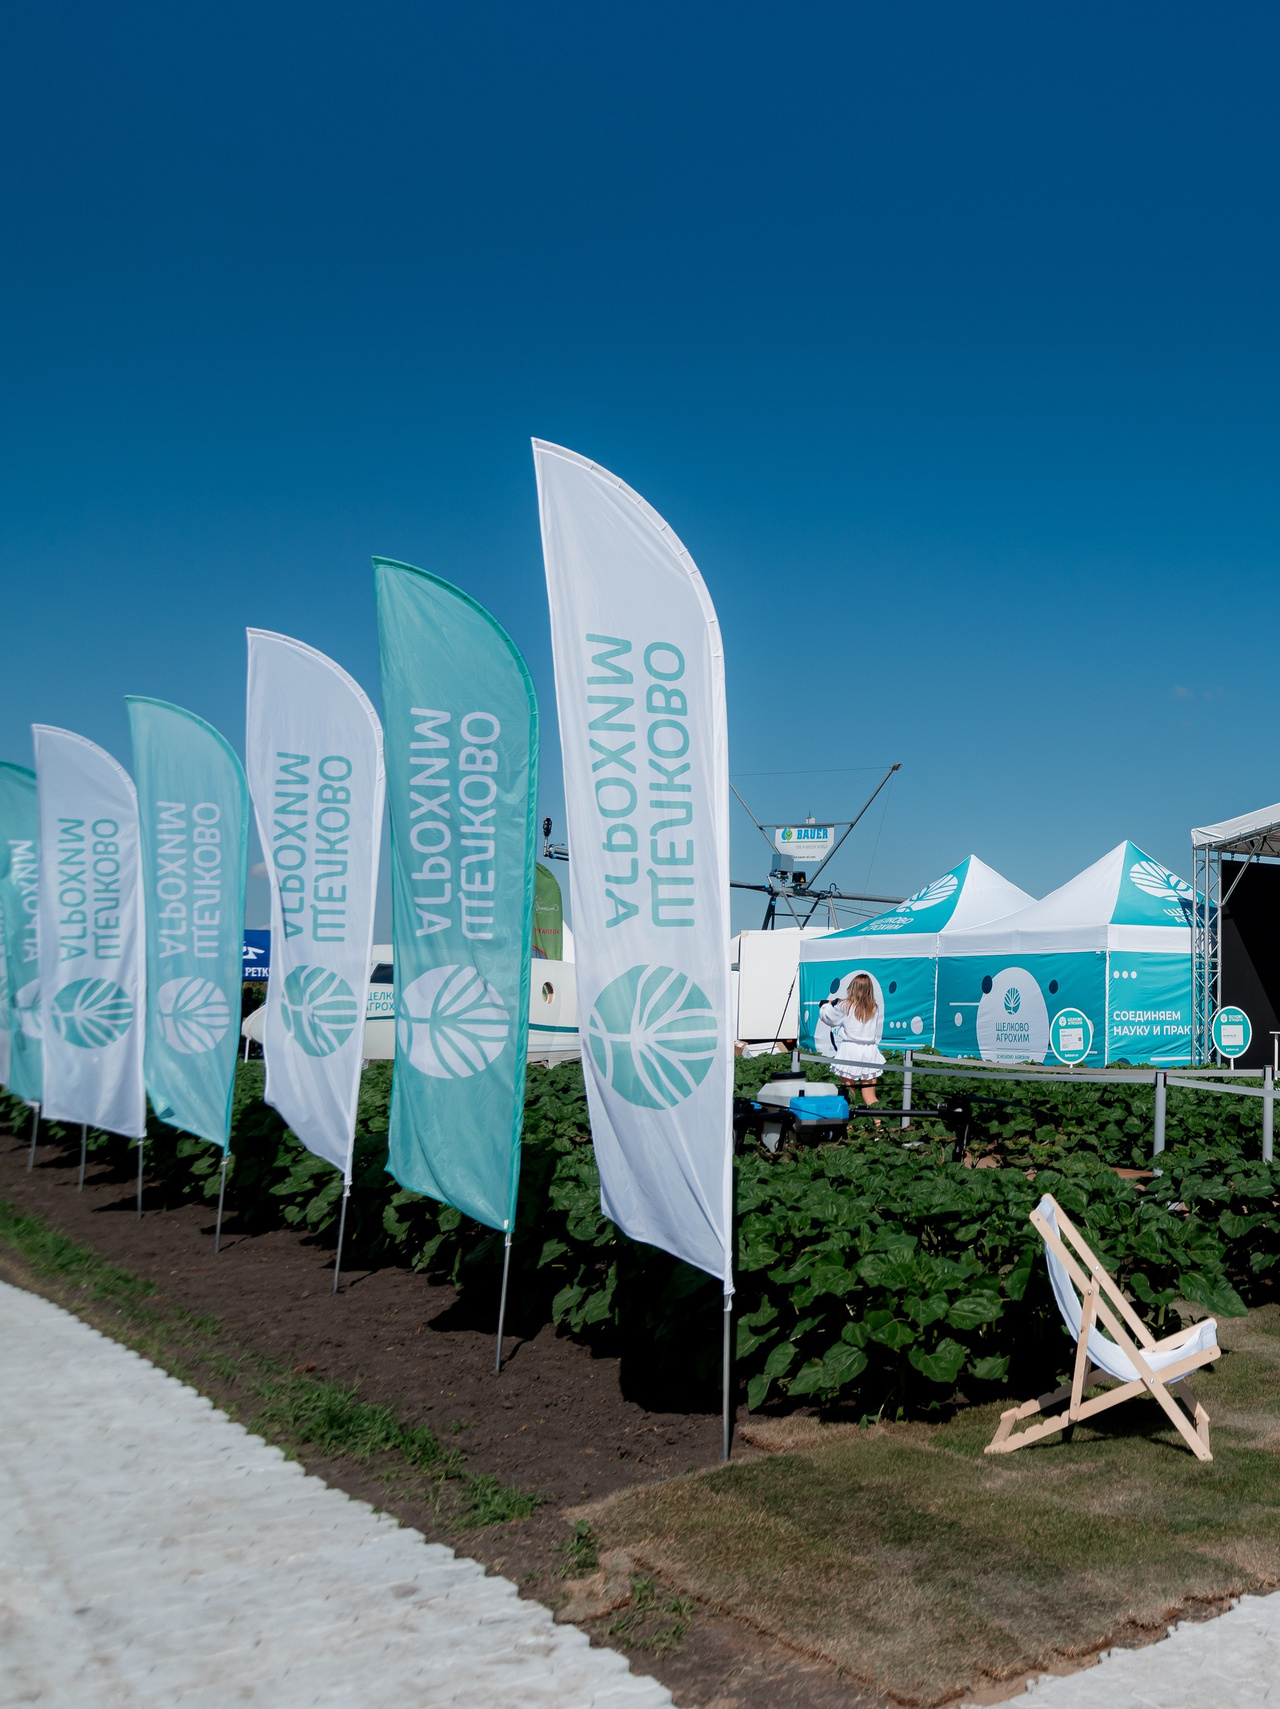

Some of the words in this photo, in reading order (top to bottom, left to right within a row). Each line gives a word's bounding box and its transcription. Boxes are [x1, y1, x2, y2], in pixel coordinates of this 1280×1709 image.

[796, 828, 828, 840] BAUER
[1113, 1010, 1181, 1023] СОЕДИНЯЕМ
[995, 1022, 1030, 1032] ЩЕЛКОВО
[1113, 1025, 1151, 1036] НАУКУ
[1153, 1026, 1161, 1036] И
[1163, 1025, 1192, 1036] ПРАК
[995, 1033, 1030, 1043] АГРОХИМ
